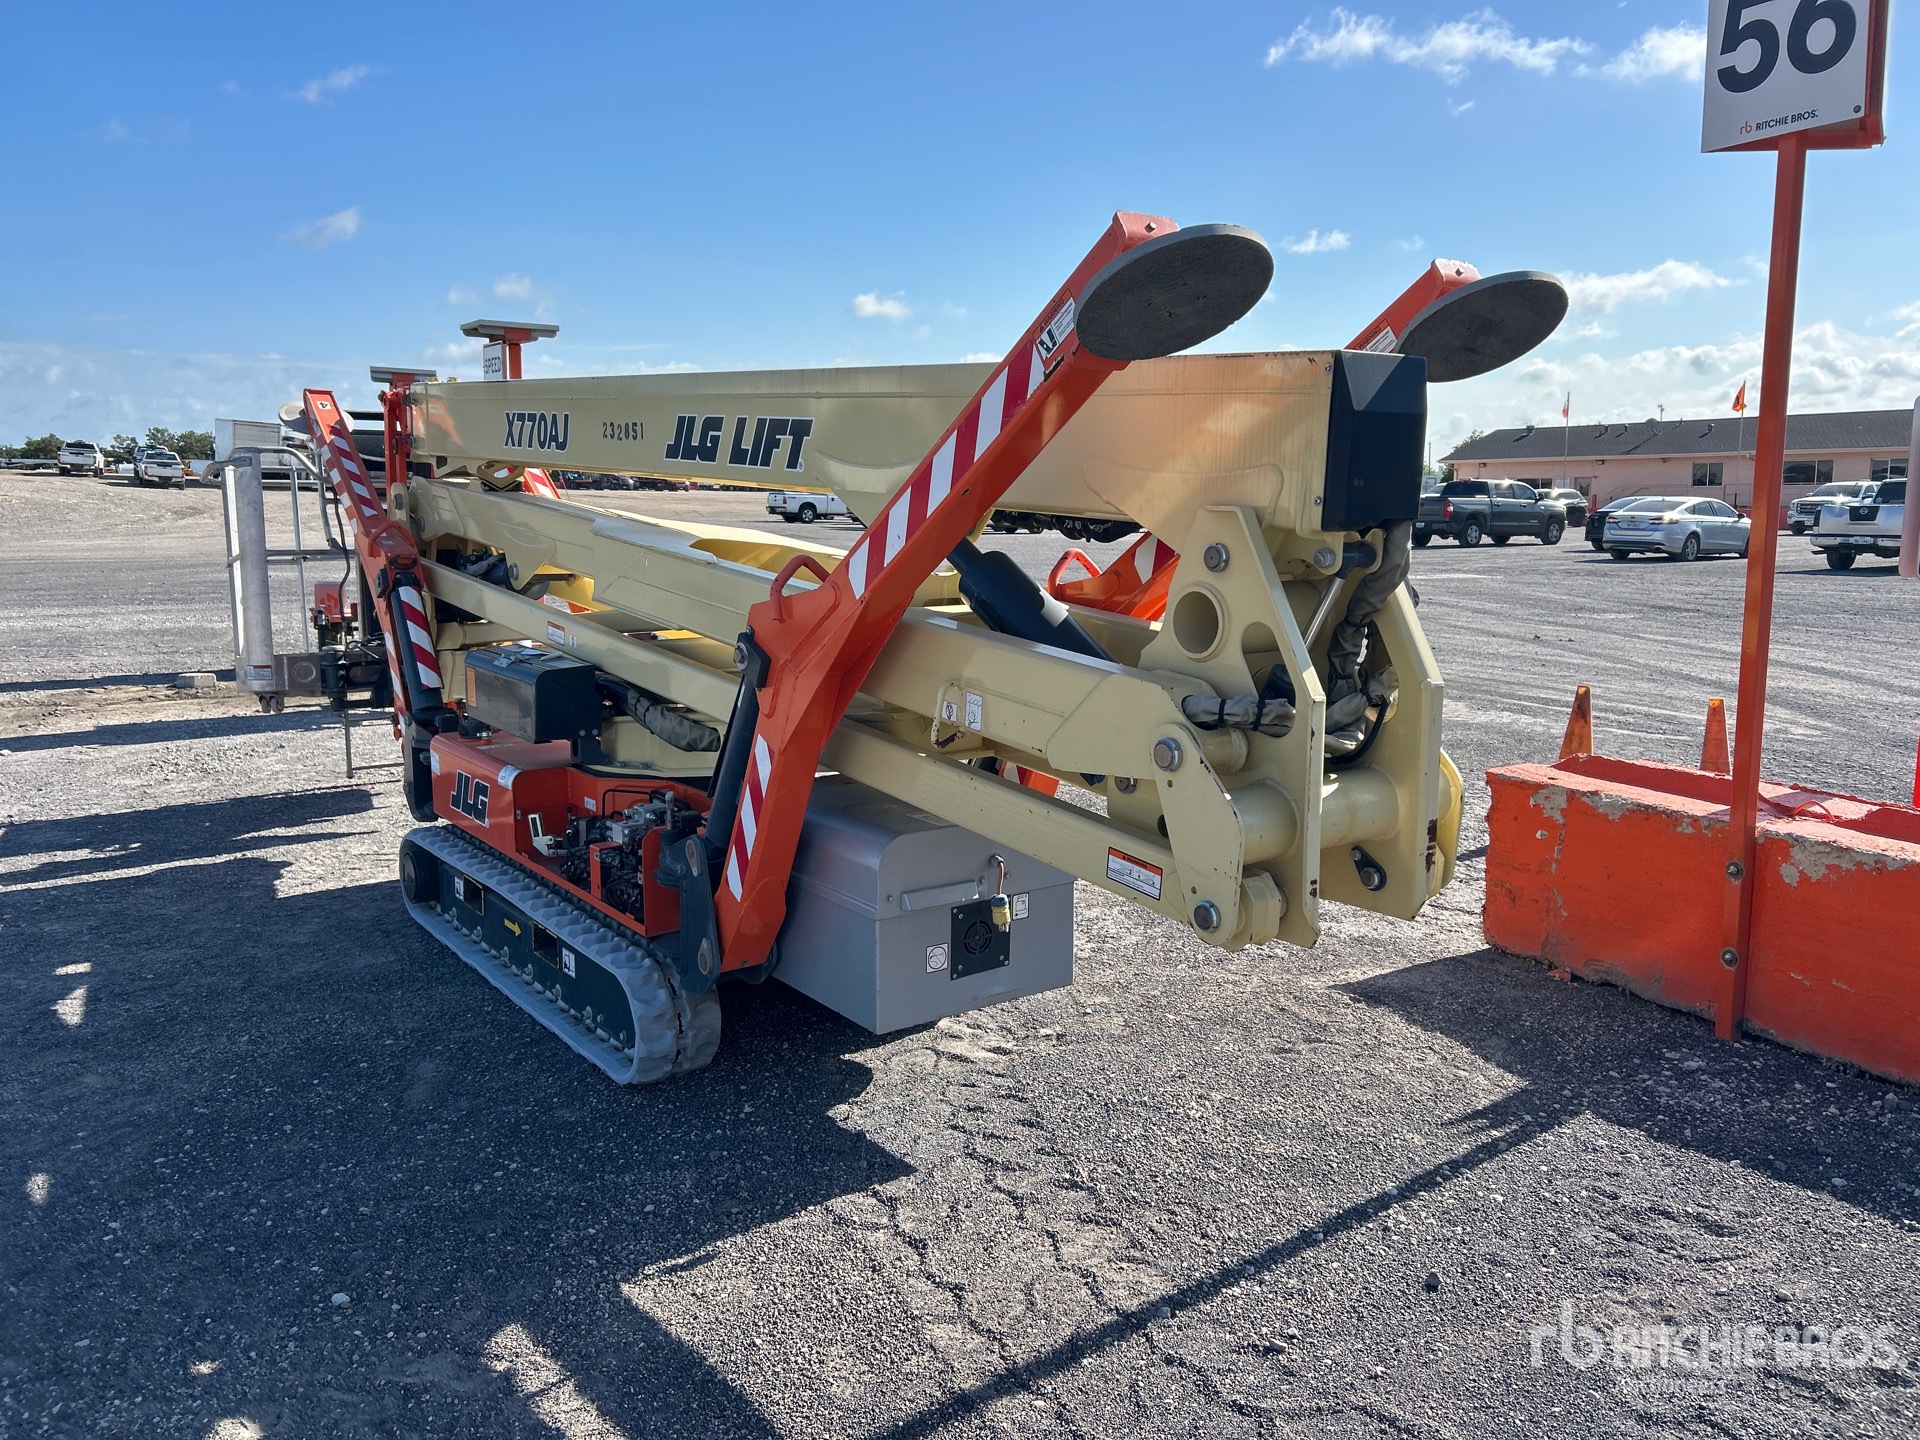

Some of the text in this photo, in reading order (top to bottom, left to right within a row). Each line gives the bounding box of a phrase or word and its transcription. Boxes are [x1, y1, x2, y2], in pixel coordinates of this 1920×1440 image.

[1717, 0, 1857, 93] 56
[1739, 120, 1753, 135] rb
[1755, 115, 1789, 132] RITCHIE
[1044, 298, 1065, 326] WARNING
[1358, 326, 1382, 349] WARNING
[485, 356, 501, 374] SPEED
[504, 412, 570, 452] X770AJ
[602, 421, 644, 441] 232851
[664, 415, 814, 471] JLG LIFT
[450, 769, 490, 827] JLG
